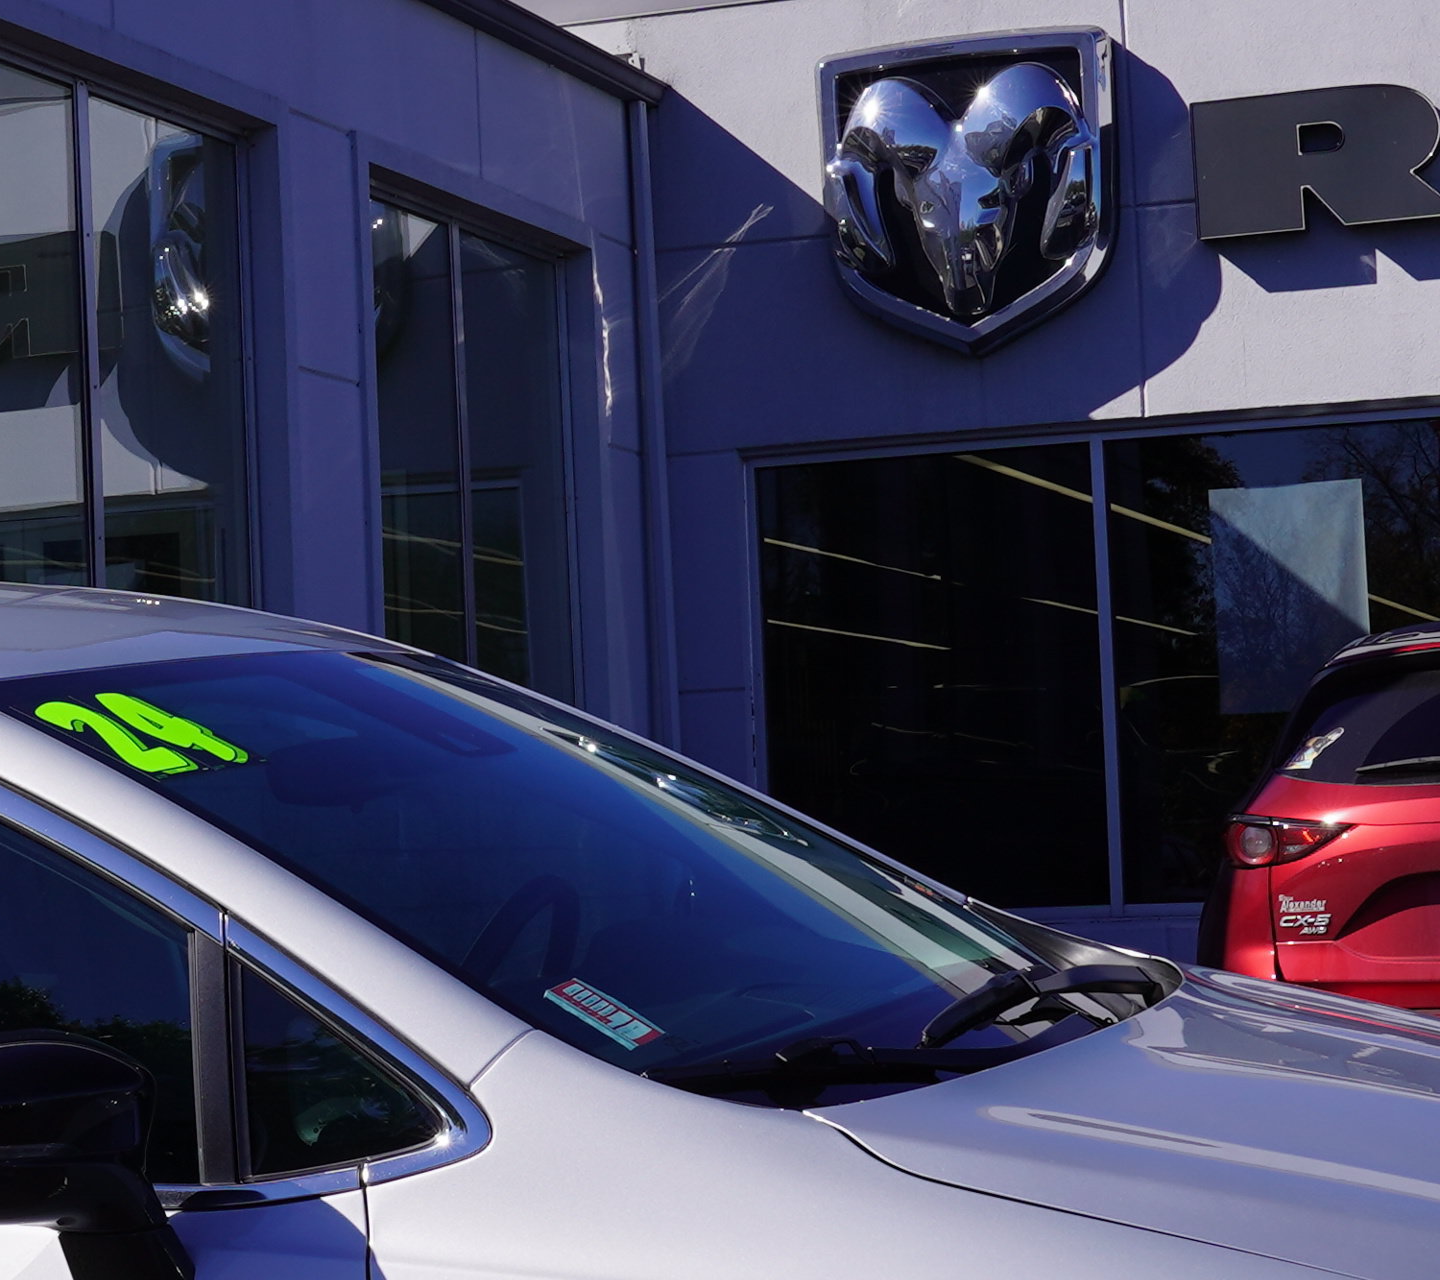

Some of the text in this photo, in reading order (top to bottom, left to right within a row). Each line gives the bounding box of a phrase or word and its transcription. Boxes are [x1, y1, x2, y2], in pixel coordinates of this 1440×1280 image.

[34, 692, 249, 775] 24
[1280, 899, 1327, 913] Alexander
[1279, 913, 1332, 928] CX-5
[1299, 926, 1328, 935] AWD
